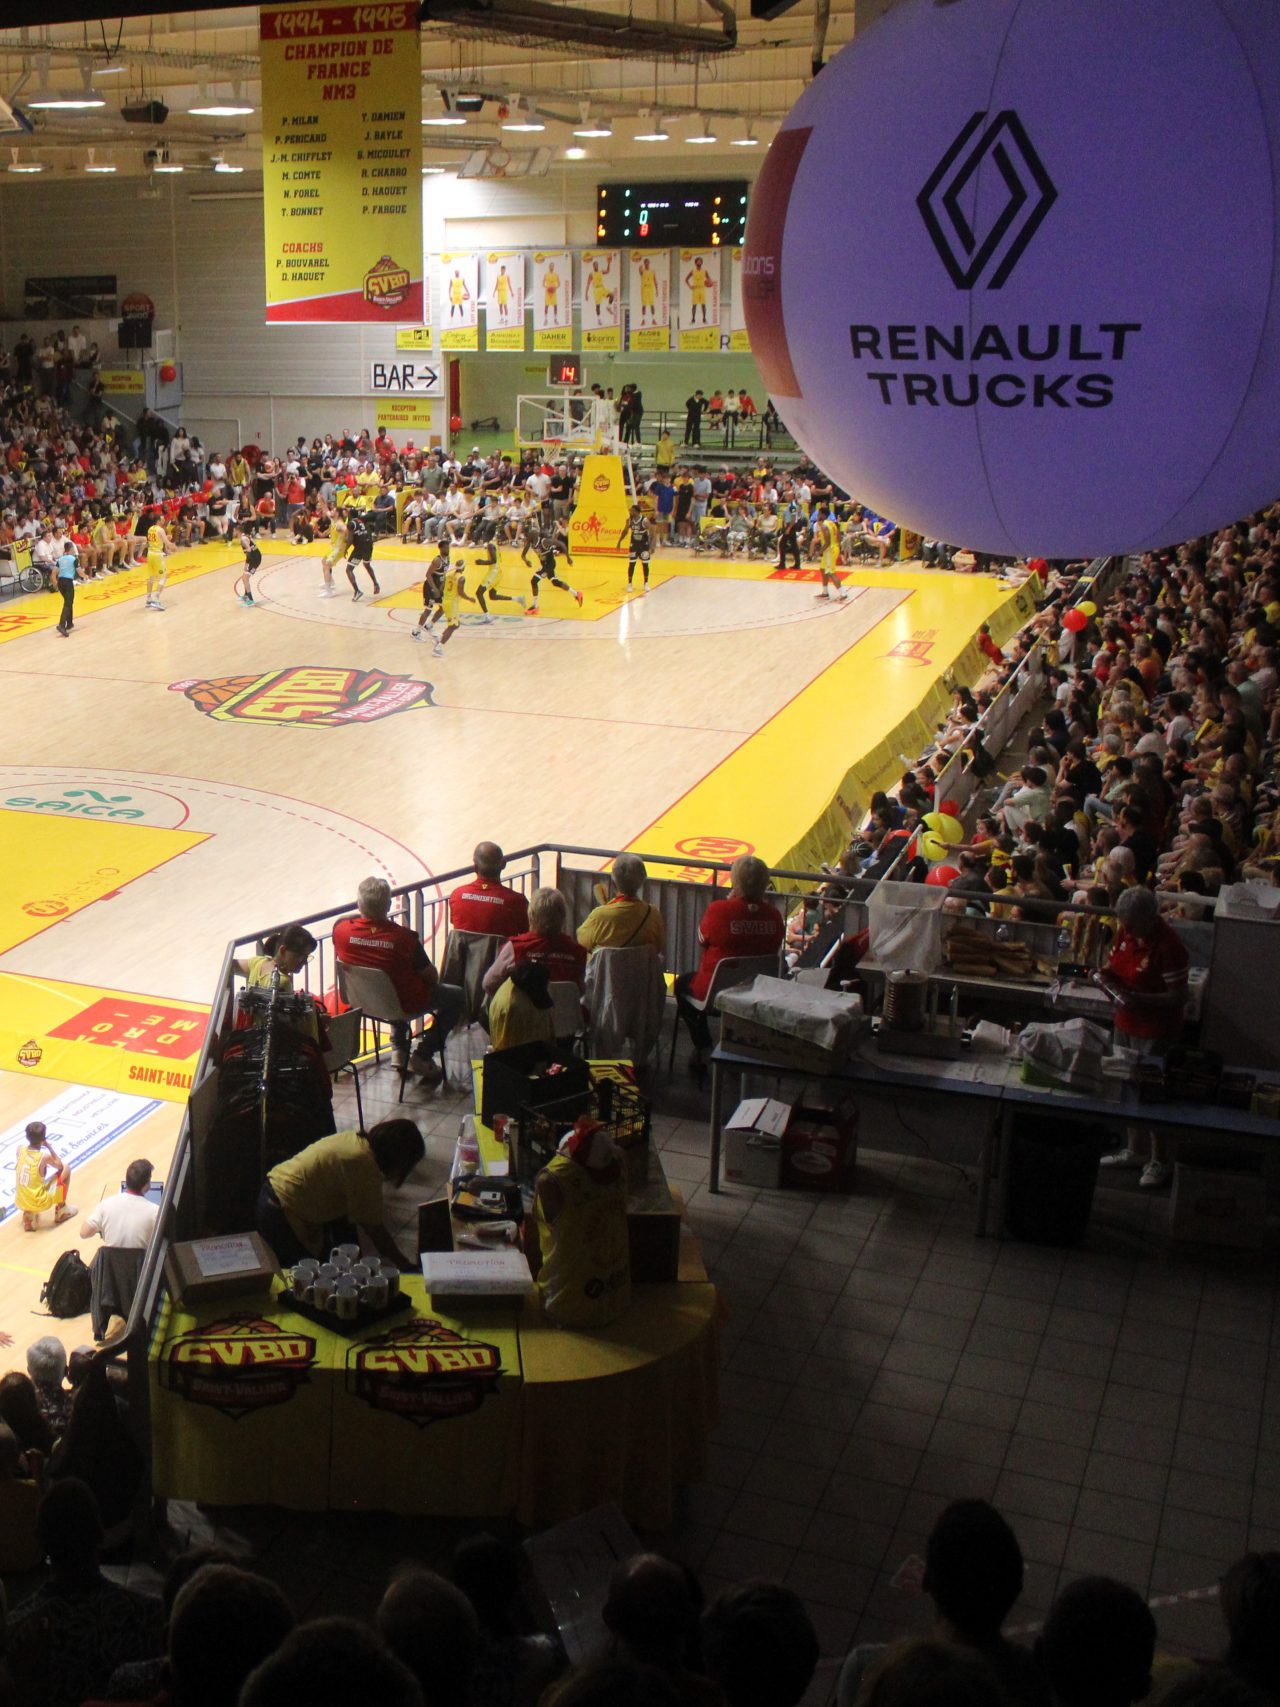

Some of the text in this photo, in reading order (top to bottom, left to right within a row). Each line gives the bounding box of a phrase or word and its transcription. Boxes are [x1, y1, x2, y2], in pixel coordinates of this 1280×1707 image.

[274, 5, 407, 37] 1994 1995
[284, 38, 394, 61] CHAMPION DE
[307, 61, 371, 80] FRANCE
[322, 84, 356, 101] NM3
[292, 115, 319, 126] MILAN
[371, 112, 406, 122] DAMIEN
[292, 151, 333, 161] CHIFFLET
[293, 170, 321, 180] COMTE
[294, 189, 320, 198] FOREL
[291, 207, 323, 216] BONNET
[282, 242, 323, 253] COACHS
[286, 259, 330, 268] BOUVAREL
[368, 273, 409, 295] SVBD
[850, 323, 1143, 362] RENAULT
[373, 364, 415, 391] BAR
[561, 366, 576, 381] 14
[867, 372, 1115, 409] TRUCKS
[461, 892, 505, 906] ORGANISATION
[348, 935, 395, 950] ORGANISATION
[177, 1338, 310, 1370] SVBD
[363, 1348, 492, 1378] SVBD
